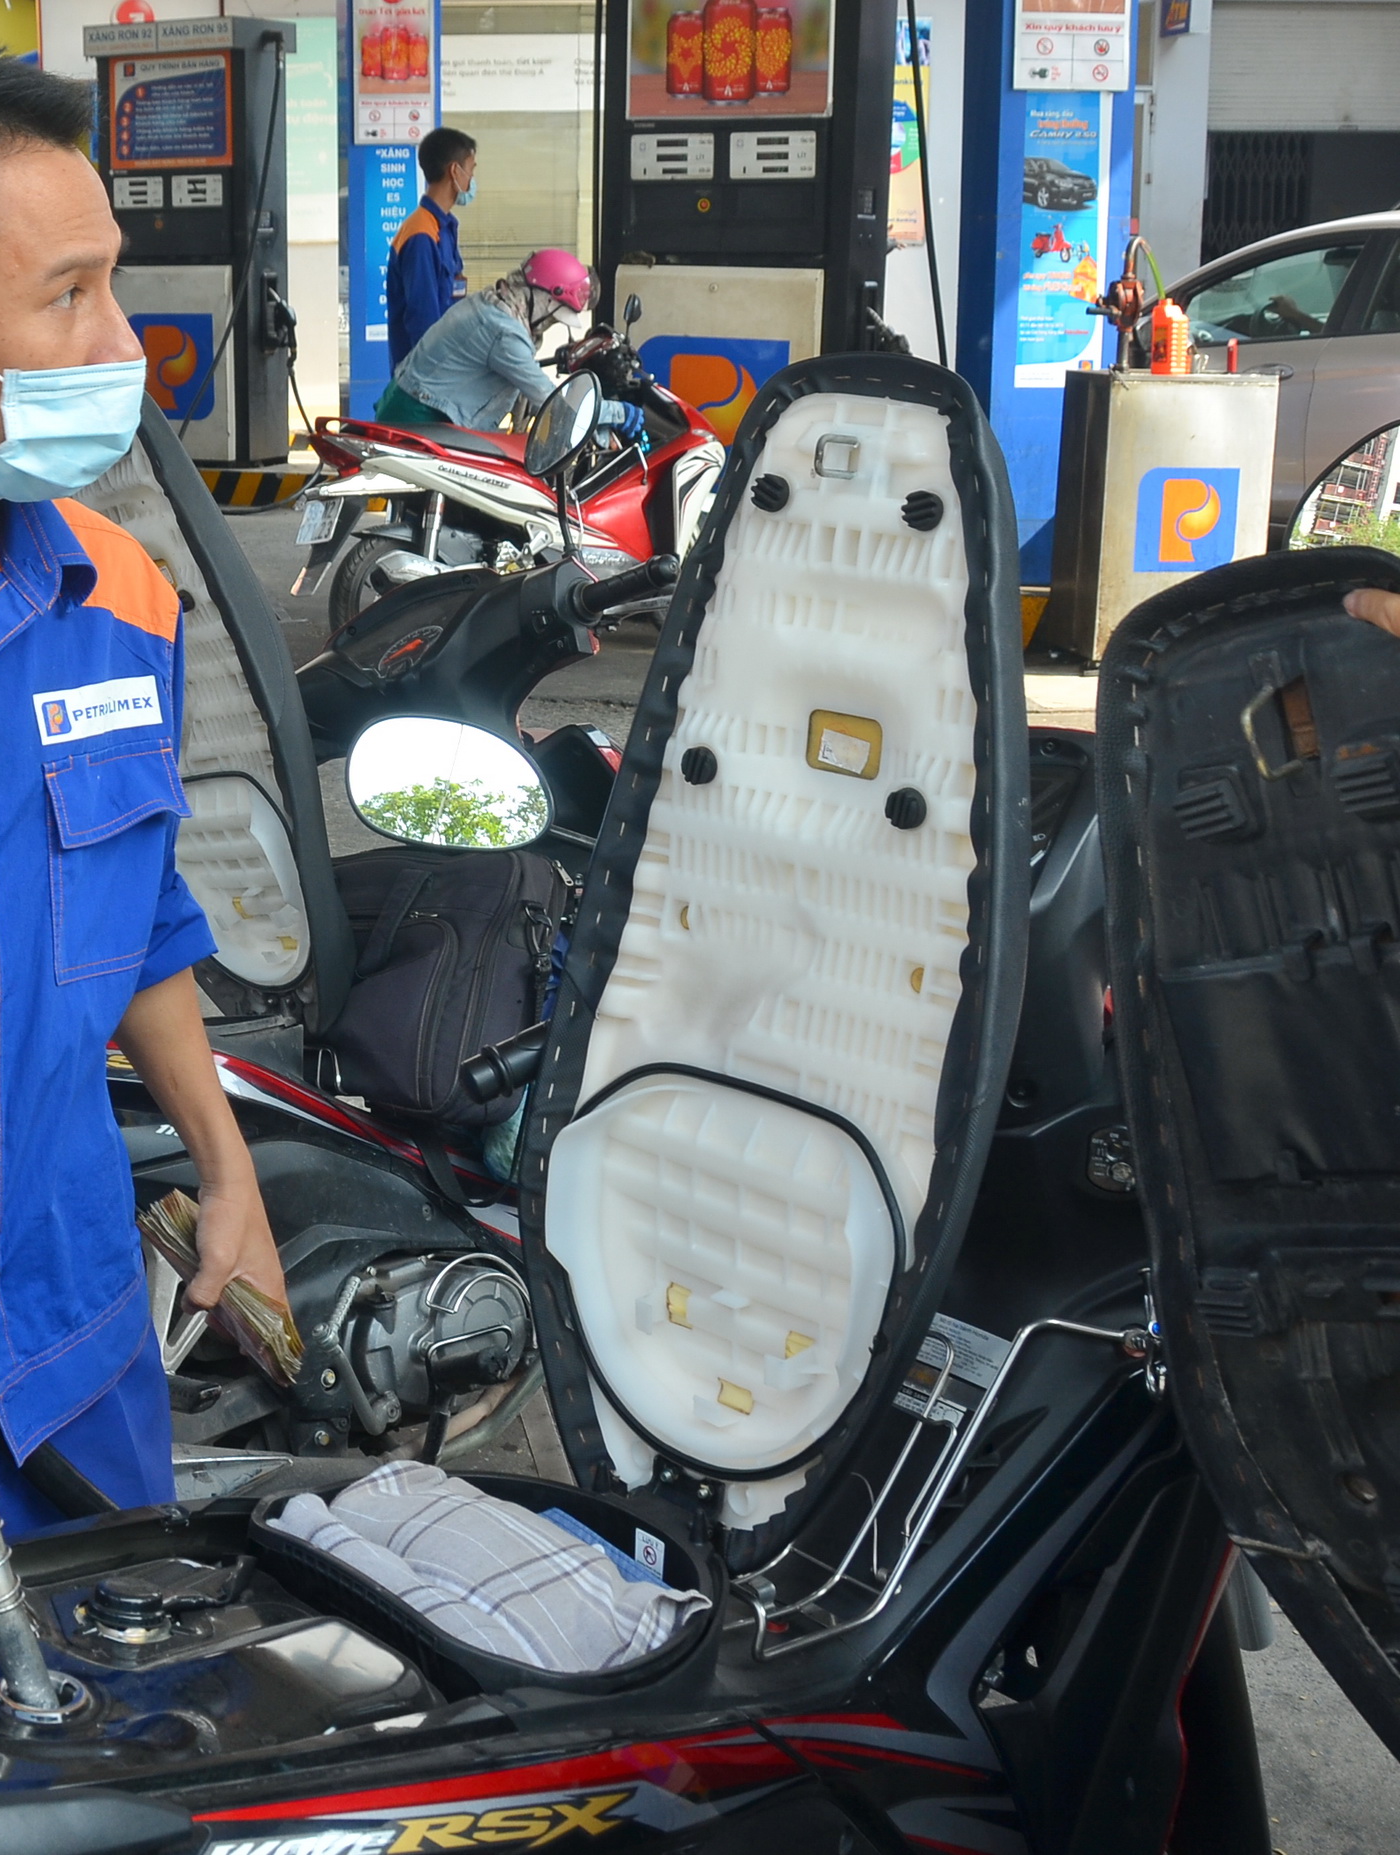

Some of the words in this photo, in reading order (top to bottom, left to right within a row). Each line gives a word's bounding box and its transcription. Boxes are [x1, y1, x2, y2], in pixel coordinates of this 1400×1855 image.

[192, 23, 214, 34] RON
[218, 22, 229, 33] 95
[1025, 23, 1042, 31] Xin
[1065, 23, 1096, 31] khách
[118, 30, 139, 40] RON
[141, 28, 152, 38] 92
[380, 163, 406, 173] SINH
[382, 178, 404, 190] HỌC
[380, 206, 406, 218] HIỆU
[387, 1791, 630, 1855] RSX
